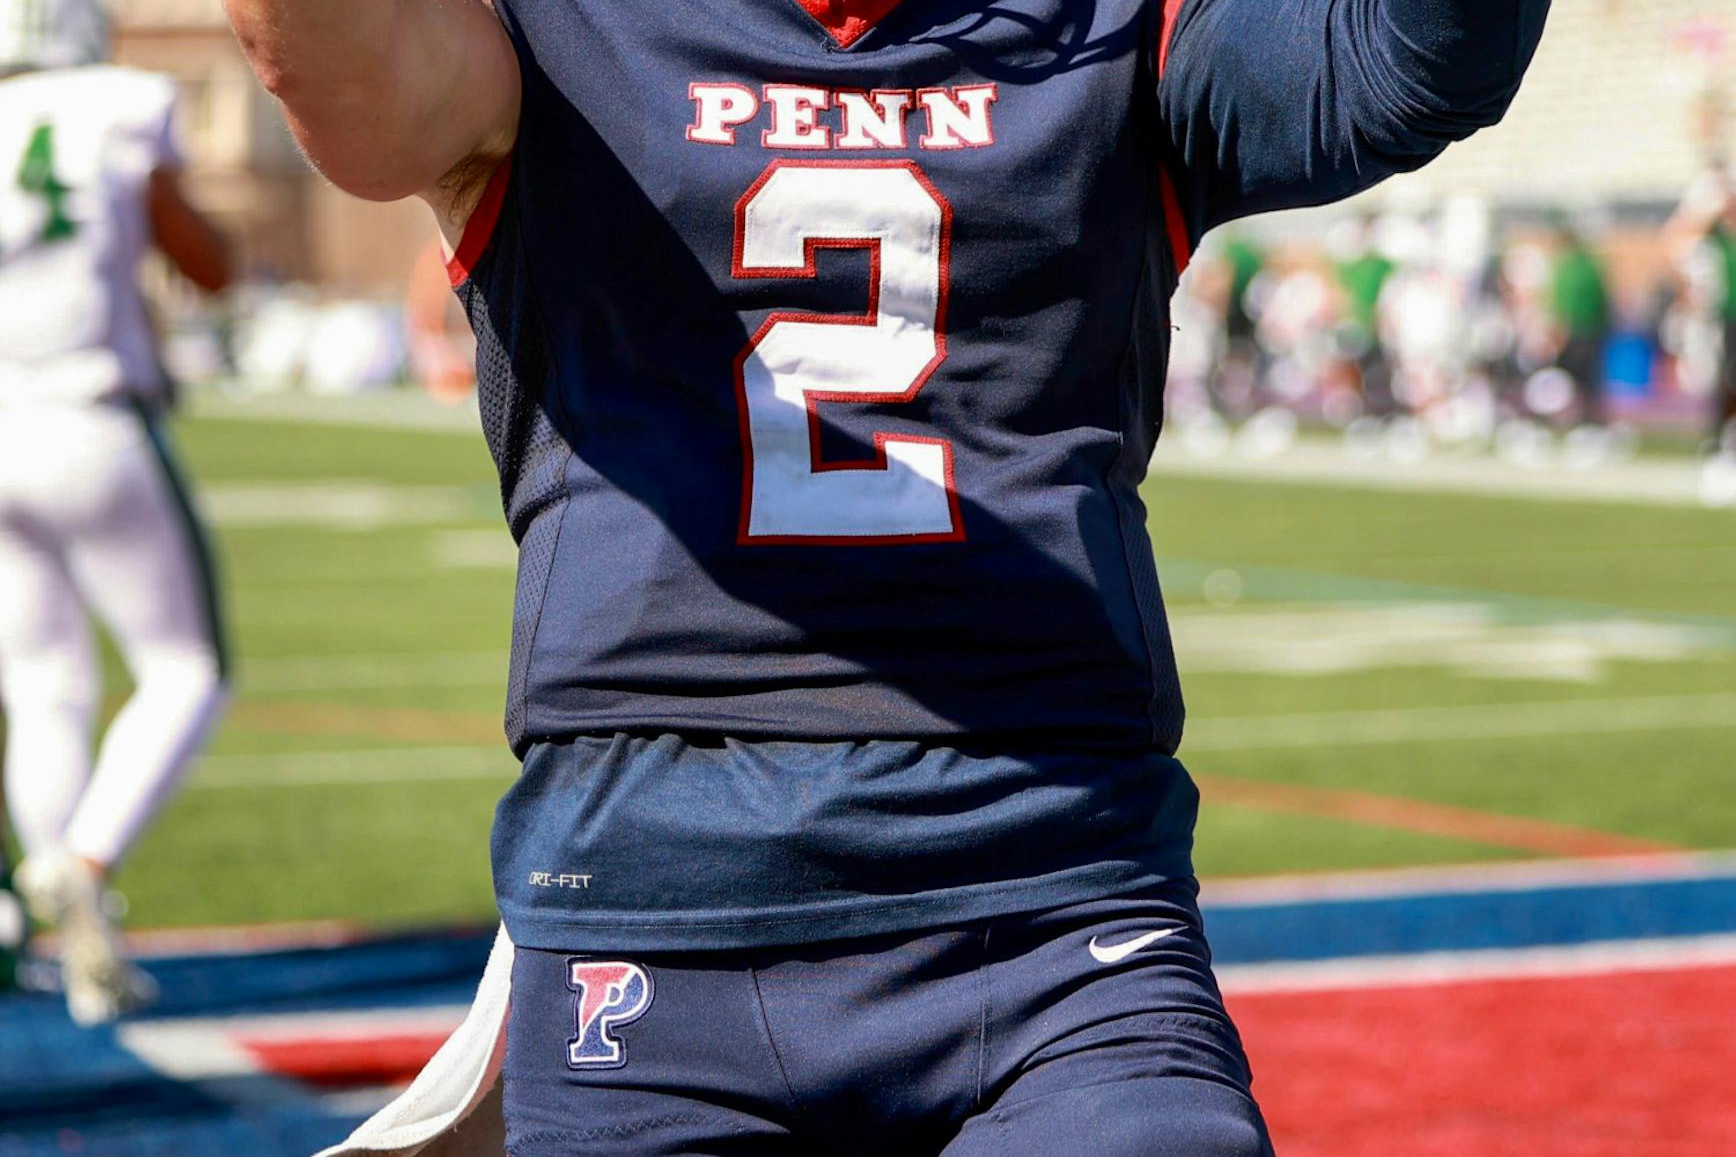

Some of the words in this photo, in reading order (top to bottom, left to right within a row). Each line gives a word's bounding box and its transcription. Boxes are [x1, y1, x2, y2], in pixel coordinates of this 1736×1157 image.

[686, 82, 997, 150] PENN
[731, 158, 967, 546] 2
[568, 960, 650, 1065] P
